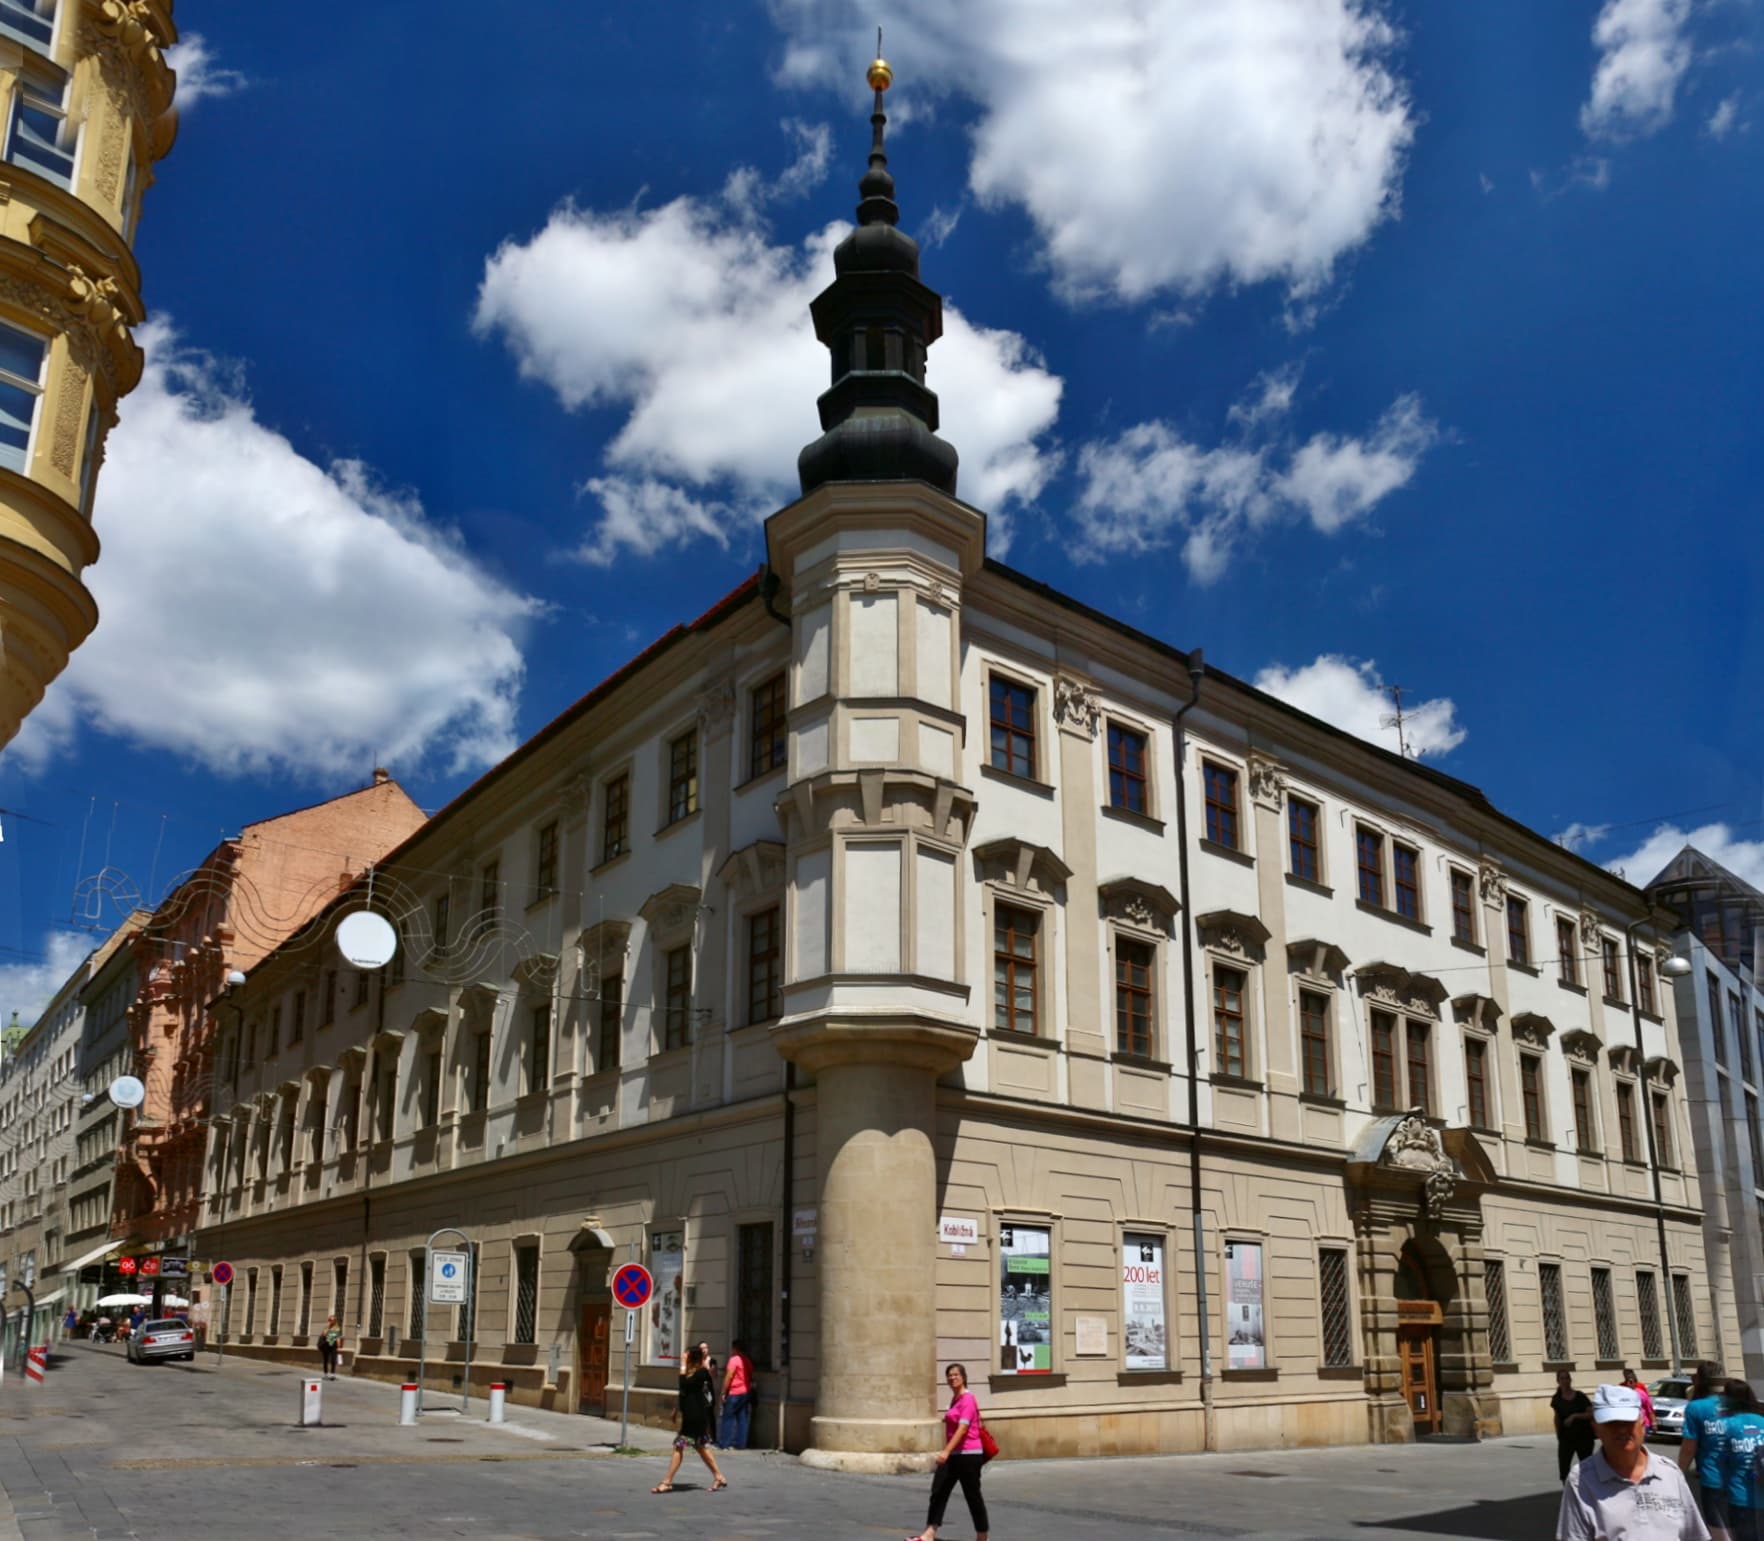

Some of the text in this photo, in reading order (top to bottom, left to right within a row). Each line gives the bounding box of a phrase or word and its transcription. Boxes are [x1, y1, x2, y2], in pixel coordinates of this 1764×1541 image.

[943, 1223, 974, 1238] Kobližná
[1123, 1266, 1160, 1284] 200 let
